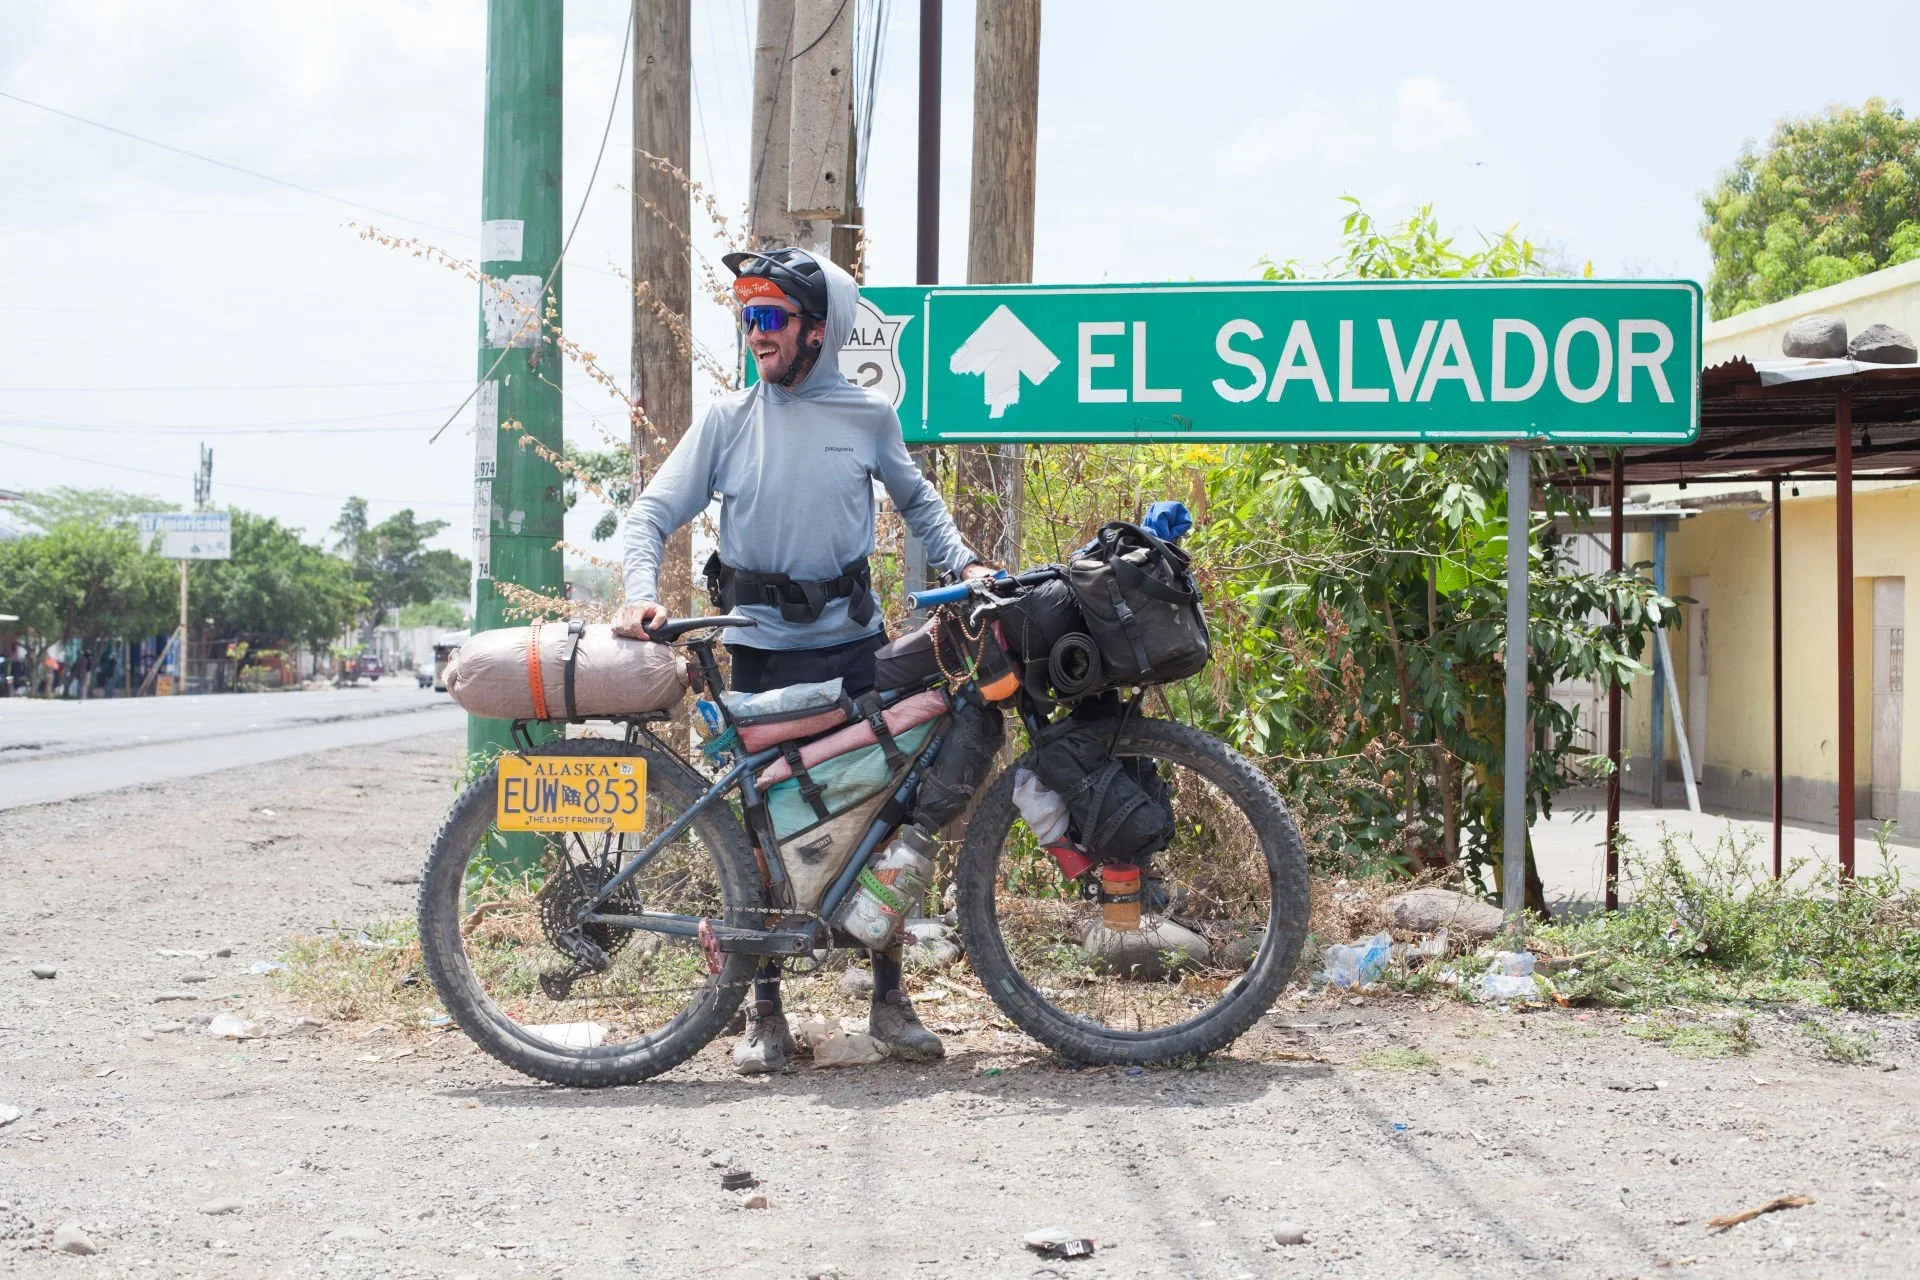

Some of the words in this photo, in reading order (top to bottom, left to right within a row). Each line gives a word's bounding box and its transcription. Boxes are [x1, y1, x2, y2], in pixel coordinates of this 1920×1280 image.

[844, 328, 886, 346] ALA
[1078, 321, 1182, 403] EL
[1212, 318, 1675, 403] SALVADOR
[534, 763, 610, 777] ALASKA
[504, 778, 559, 813] EUW
[584, 778, 639, 814] 853
[546, 816, 568, 824] LAST
[571, 816, 612, 824] FRONTIER
